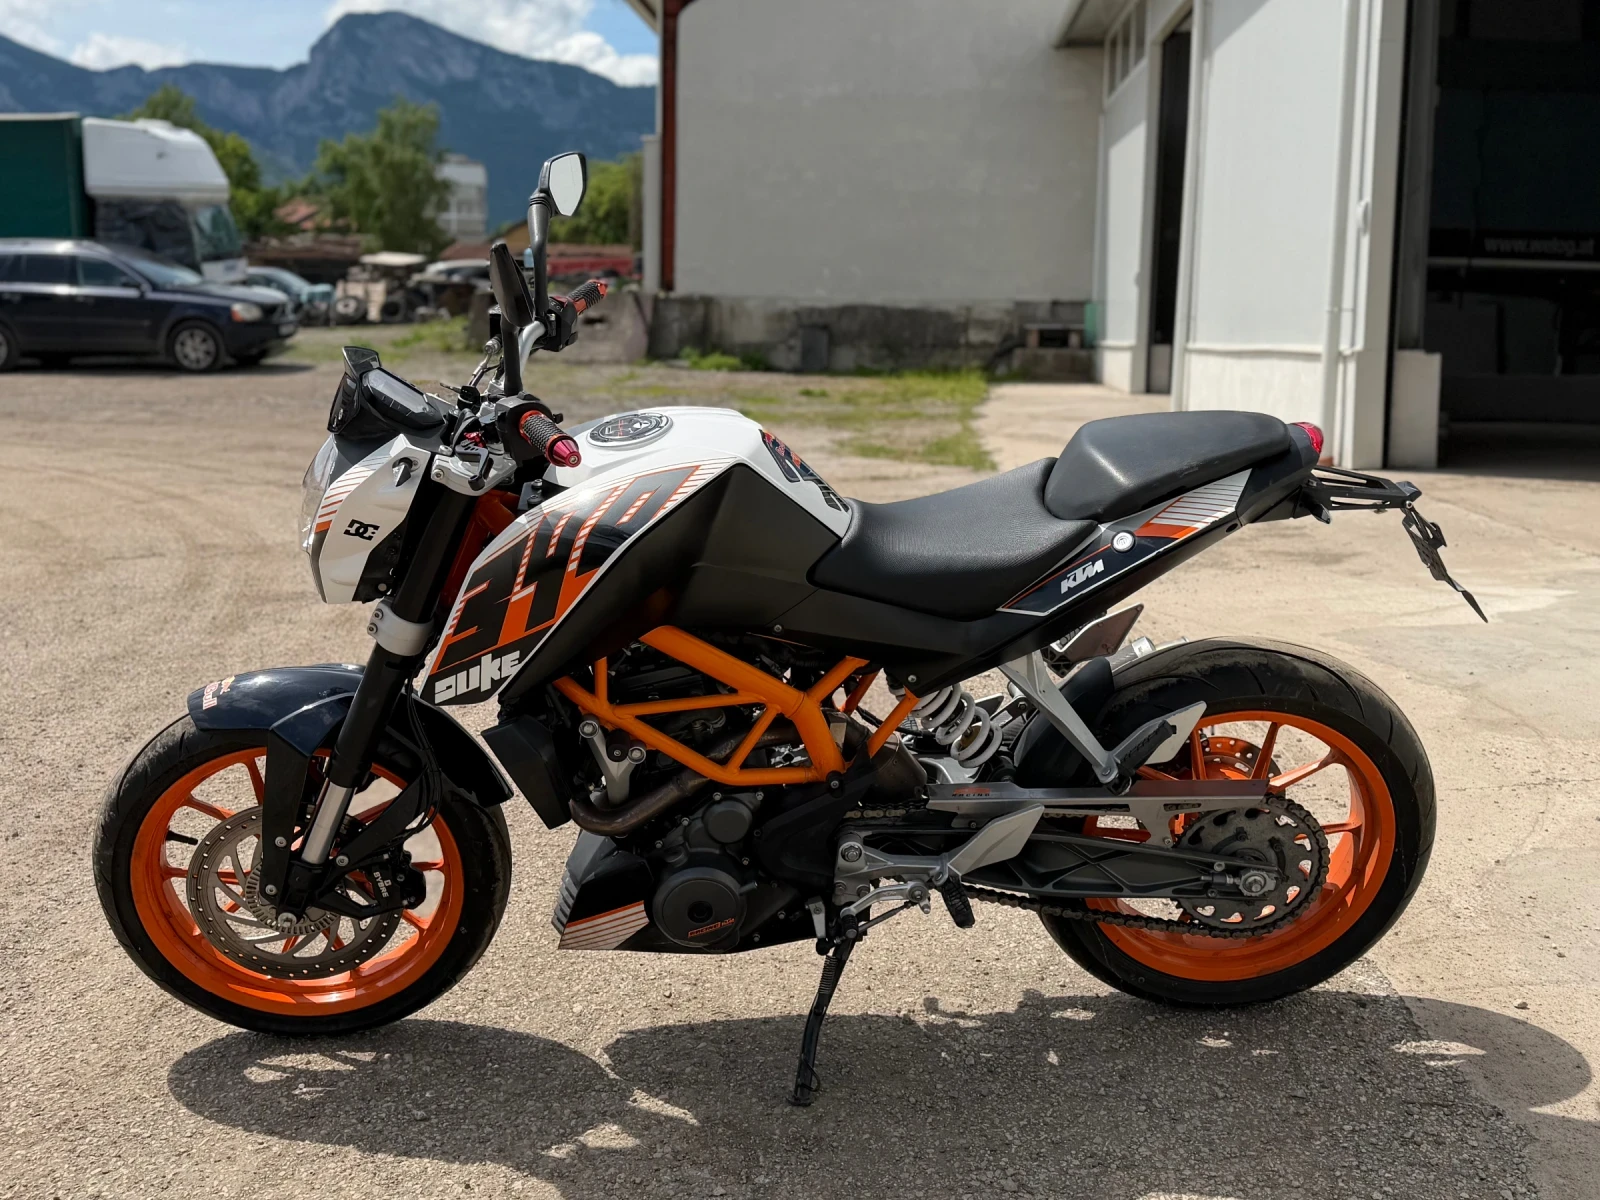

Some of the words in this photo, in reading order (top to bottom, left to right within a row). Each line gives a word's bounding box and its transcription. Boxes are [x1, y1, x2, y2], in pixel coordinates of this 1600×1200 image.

[1061, 559, 1105, 594] KTM
[434, 650, 522, 705] DUKE
[373, 871, 389, 898] BYBRE
